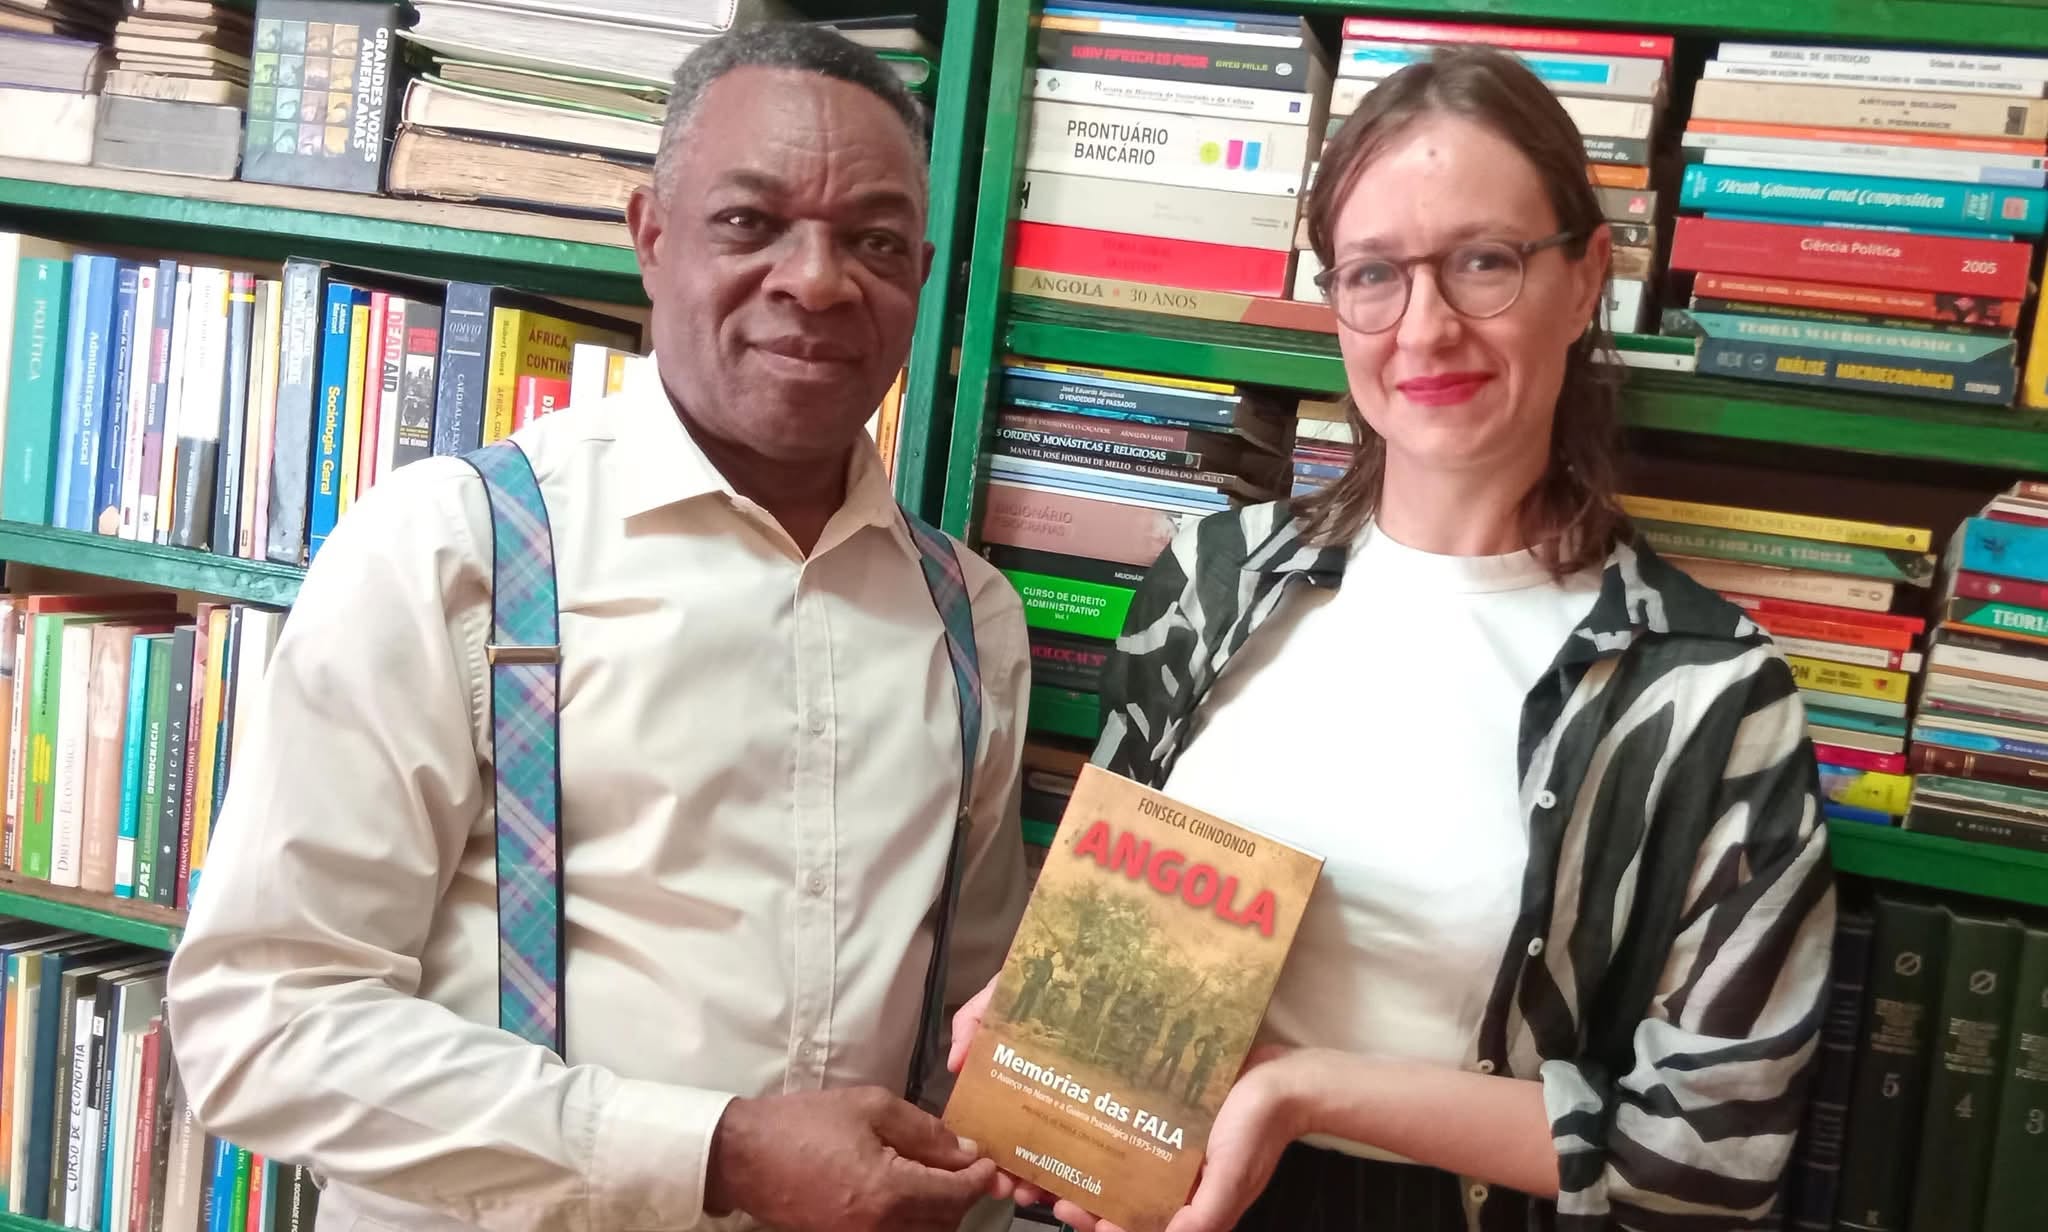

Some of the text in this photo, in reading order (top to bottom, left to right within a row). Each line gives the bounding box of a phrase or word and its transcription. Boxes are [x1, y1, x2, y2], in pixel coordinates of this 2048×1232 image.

[1216, 60, 1269, 72] GREG MILLS
[352, 38, 375, 150] AMERICANAS
[363, 27, 389, 163] GRANDES VOZES
[1067, 120, 1169, 146] PRONTUÁRIO
[1074, 142, 1156, 166] BANCÁRIO
[1761, 183, 1826, 201] Grammar
[1828, 188, 1853, 203] and
[1856, 190, 1946, 210] Composition
[1800, 237, 1901, 259] Ciência Política
[1961, 260, 1998, 275] 2005
[1031, 275, 1198, 310] ANGOLA 30 ANOS
[29, 299, 48, 383] POLÍTICA
[1738, 321, 1800, 339] TEORIA
[382, 312, 404, 394] DEAD AID
[78, 331, 99, 466] Administração Local
[455, 374, 465, 420] CARDEAL
[1060, 385, 1125, 400] José Eduardo Agualusa
[1064, 394, 1095, 405] VENDEDOR
[1105, 398, 1137, 409] PASSADOS
[319, 386, 341, 495] Sociologia Geral
[1003, 429, 1041, 443] ORDENS
[1043, 434, 1104, 453] MONÁSTICAS
[1104, 443, 1112, 453] E
[1113, 444, 1167, 462] RELIGIOSAS
[1081, 424, 1112, 434] CAÇADOR
[1120, 430, 1175, 443] ARNALDO SANTOS
[1010, 446, 1042, 459] MANUEL
[1043, 449, 1060, 461] JOSÉ
[1061, 452, 1092, 466] HOMEM
[1093, 456, 1103, 466] DE
[1104, 458, 1131, 471] MELLO
[1136, 463, 1147, 473] OS
[1147, 464, 1179, 478] LÍDERES
[1180, 470, 1192, 480] DO
[1023, 586, 1107, 607] CURSO DE DIREITO
[1026, 599, 1100, 618] ADMINISTRATIVO
[165, 720, 181, 818] AFRICANA
[138, 721, 161, 898] PAZ DEMOCRACIA
[179, 746, 197, 879] FINANÇAS PÚBLICAS MUNICIPAIS
[1137, 797, 1257, 859] FONSECA CHINDONDO
[1073, 819, 1279, 938] ANGOLA
[992, 1043, 1091, 1104] Memórias
[1094, 1092, 1131, 1123] das
[1132, 1109, 1185, 1150] FALA
[1882, 1073, 1900, 1097] 5
[67, 1043, 86, 1192] CURSO DE ECONOMIA
[990, 1068, 997, 1078] O
[997, 1072, 1023, 1092] Avanço
[1022, 1083, 1033, 1094] no
[1033, 1088, 1054, 1105] Norte
[1090, 1115, 1129, 1142] Psicológica
[1128, 1134, 1173, 1163] (1975-1992)
[1955, 1094, 1973, 1118] 4
[2025, 1109, 2045, 1135] 3
[1015, 1145, 1102, 1195] www.AUTORES.club
[291, 1183, 301, 1218] SOCIEDADE
